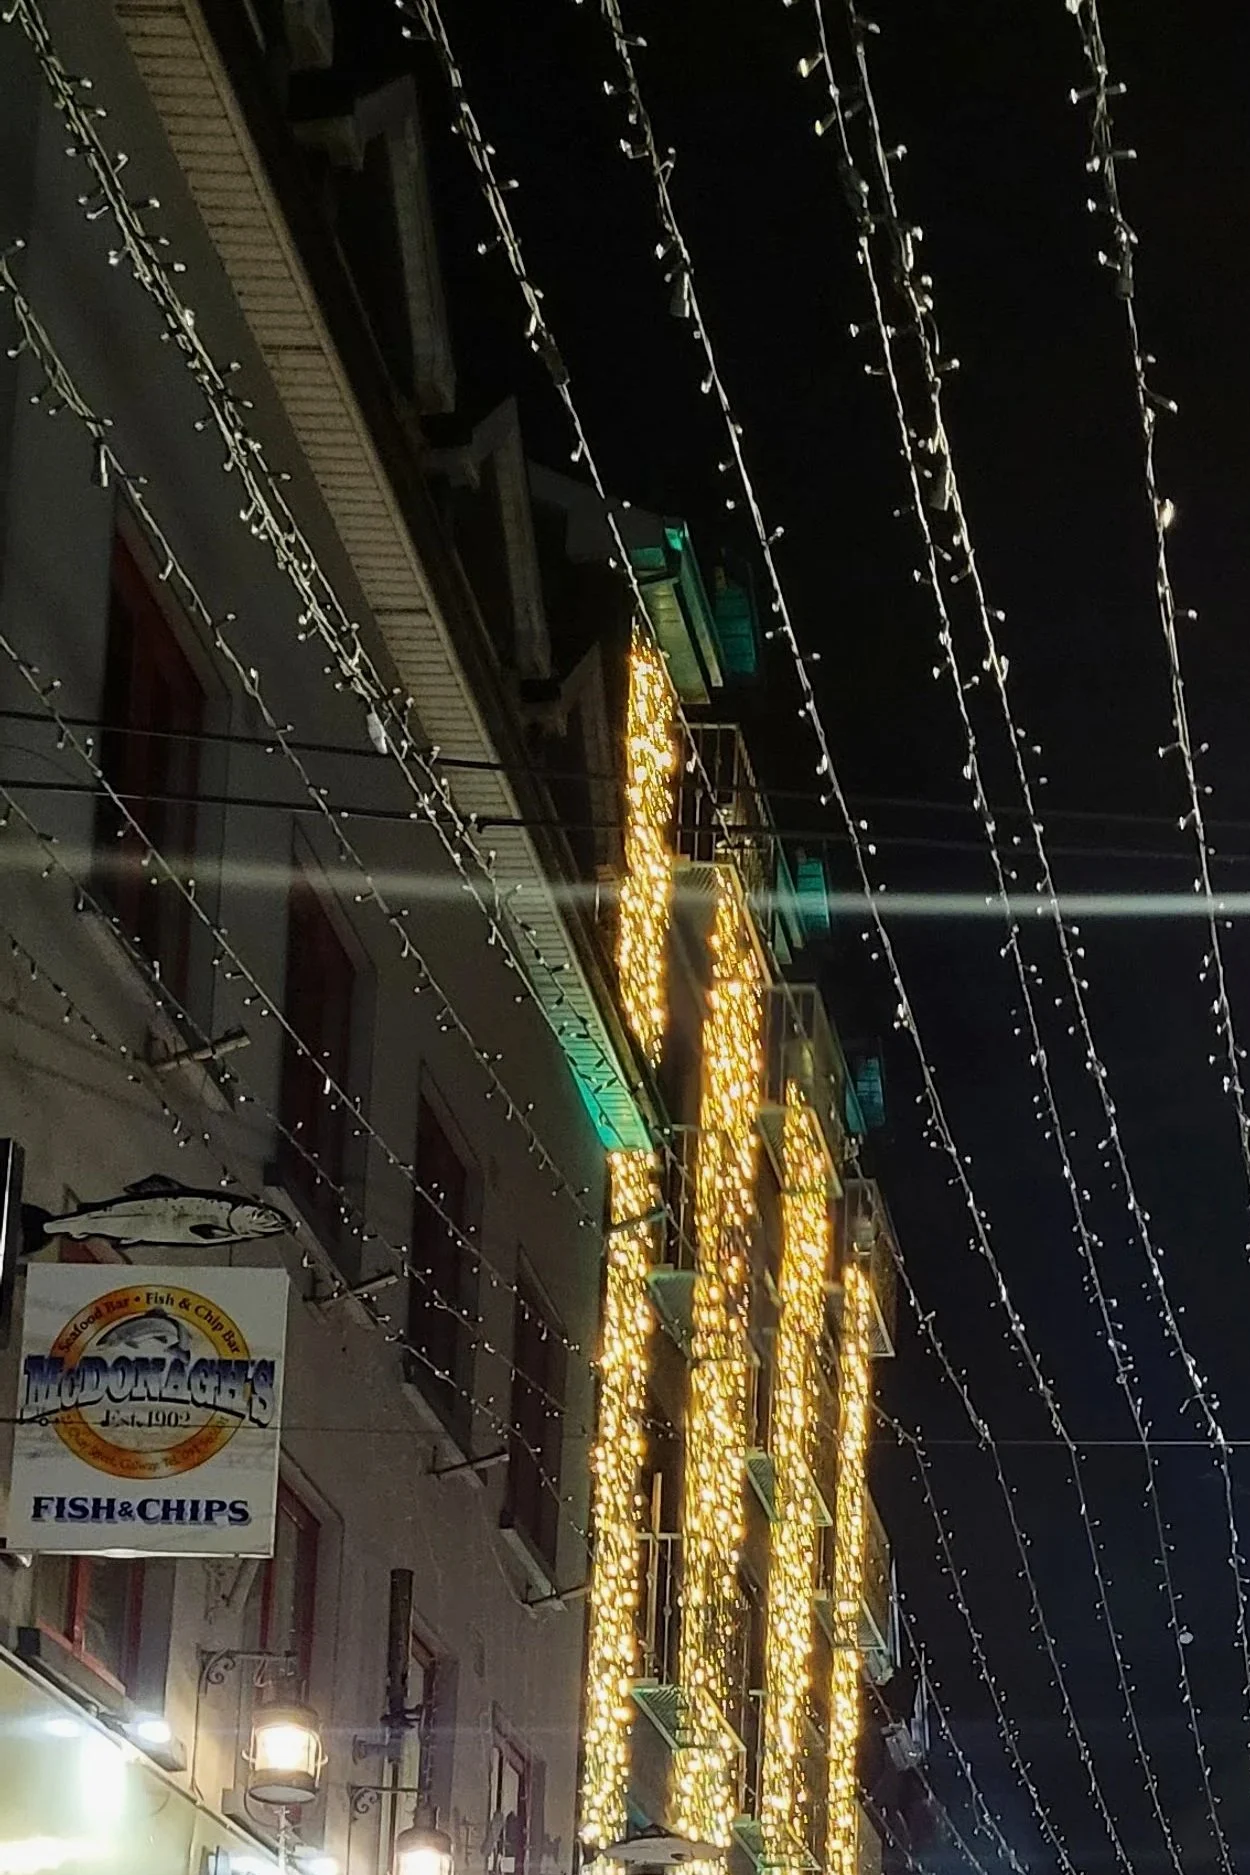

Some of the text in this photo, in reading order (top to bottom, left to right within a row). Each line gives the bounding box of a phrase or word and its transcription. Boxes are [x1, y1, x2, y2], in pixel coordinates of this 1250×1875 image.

[58, 1291, 241, 1354] Seafood Bar Fish & Chip Bar
